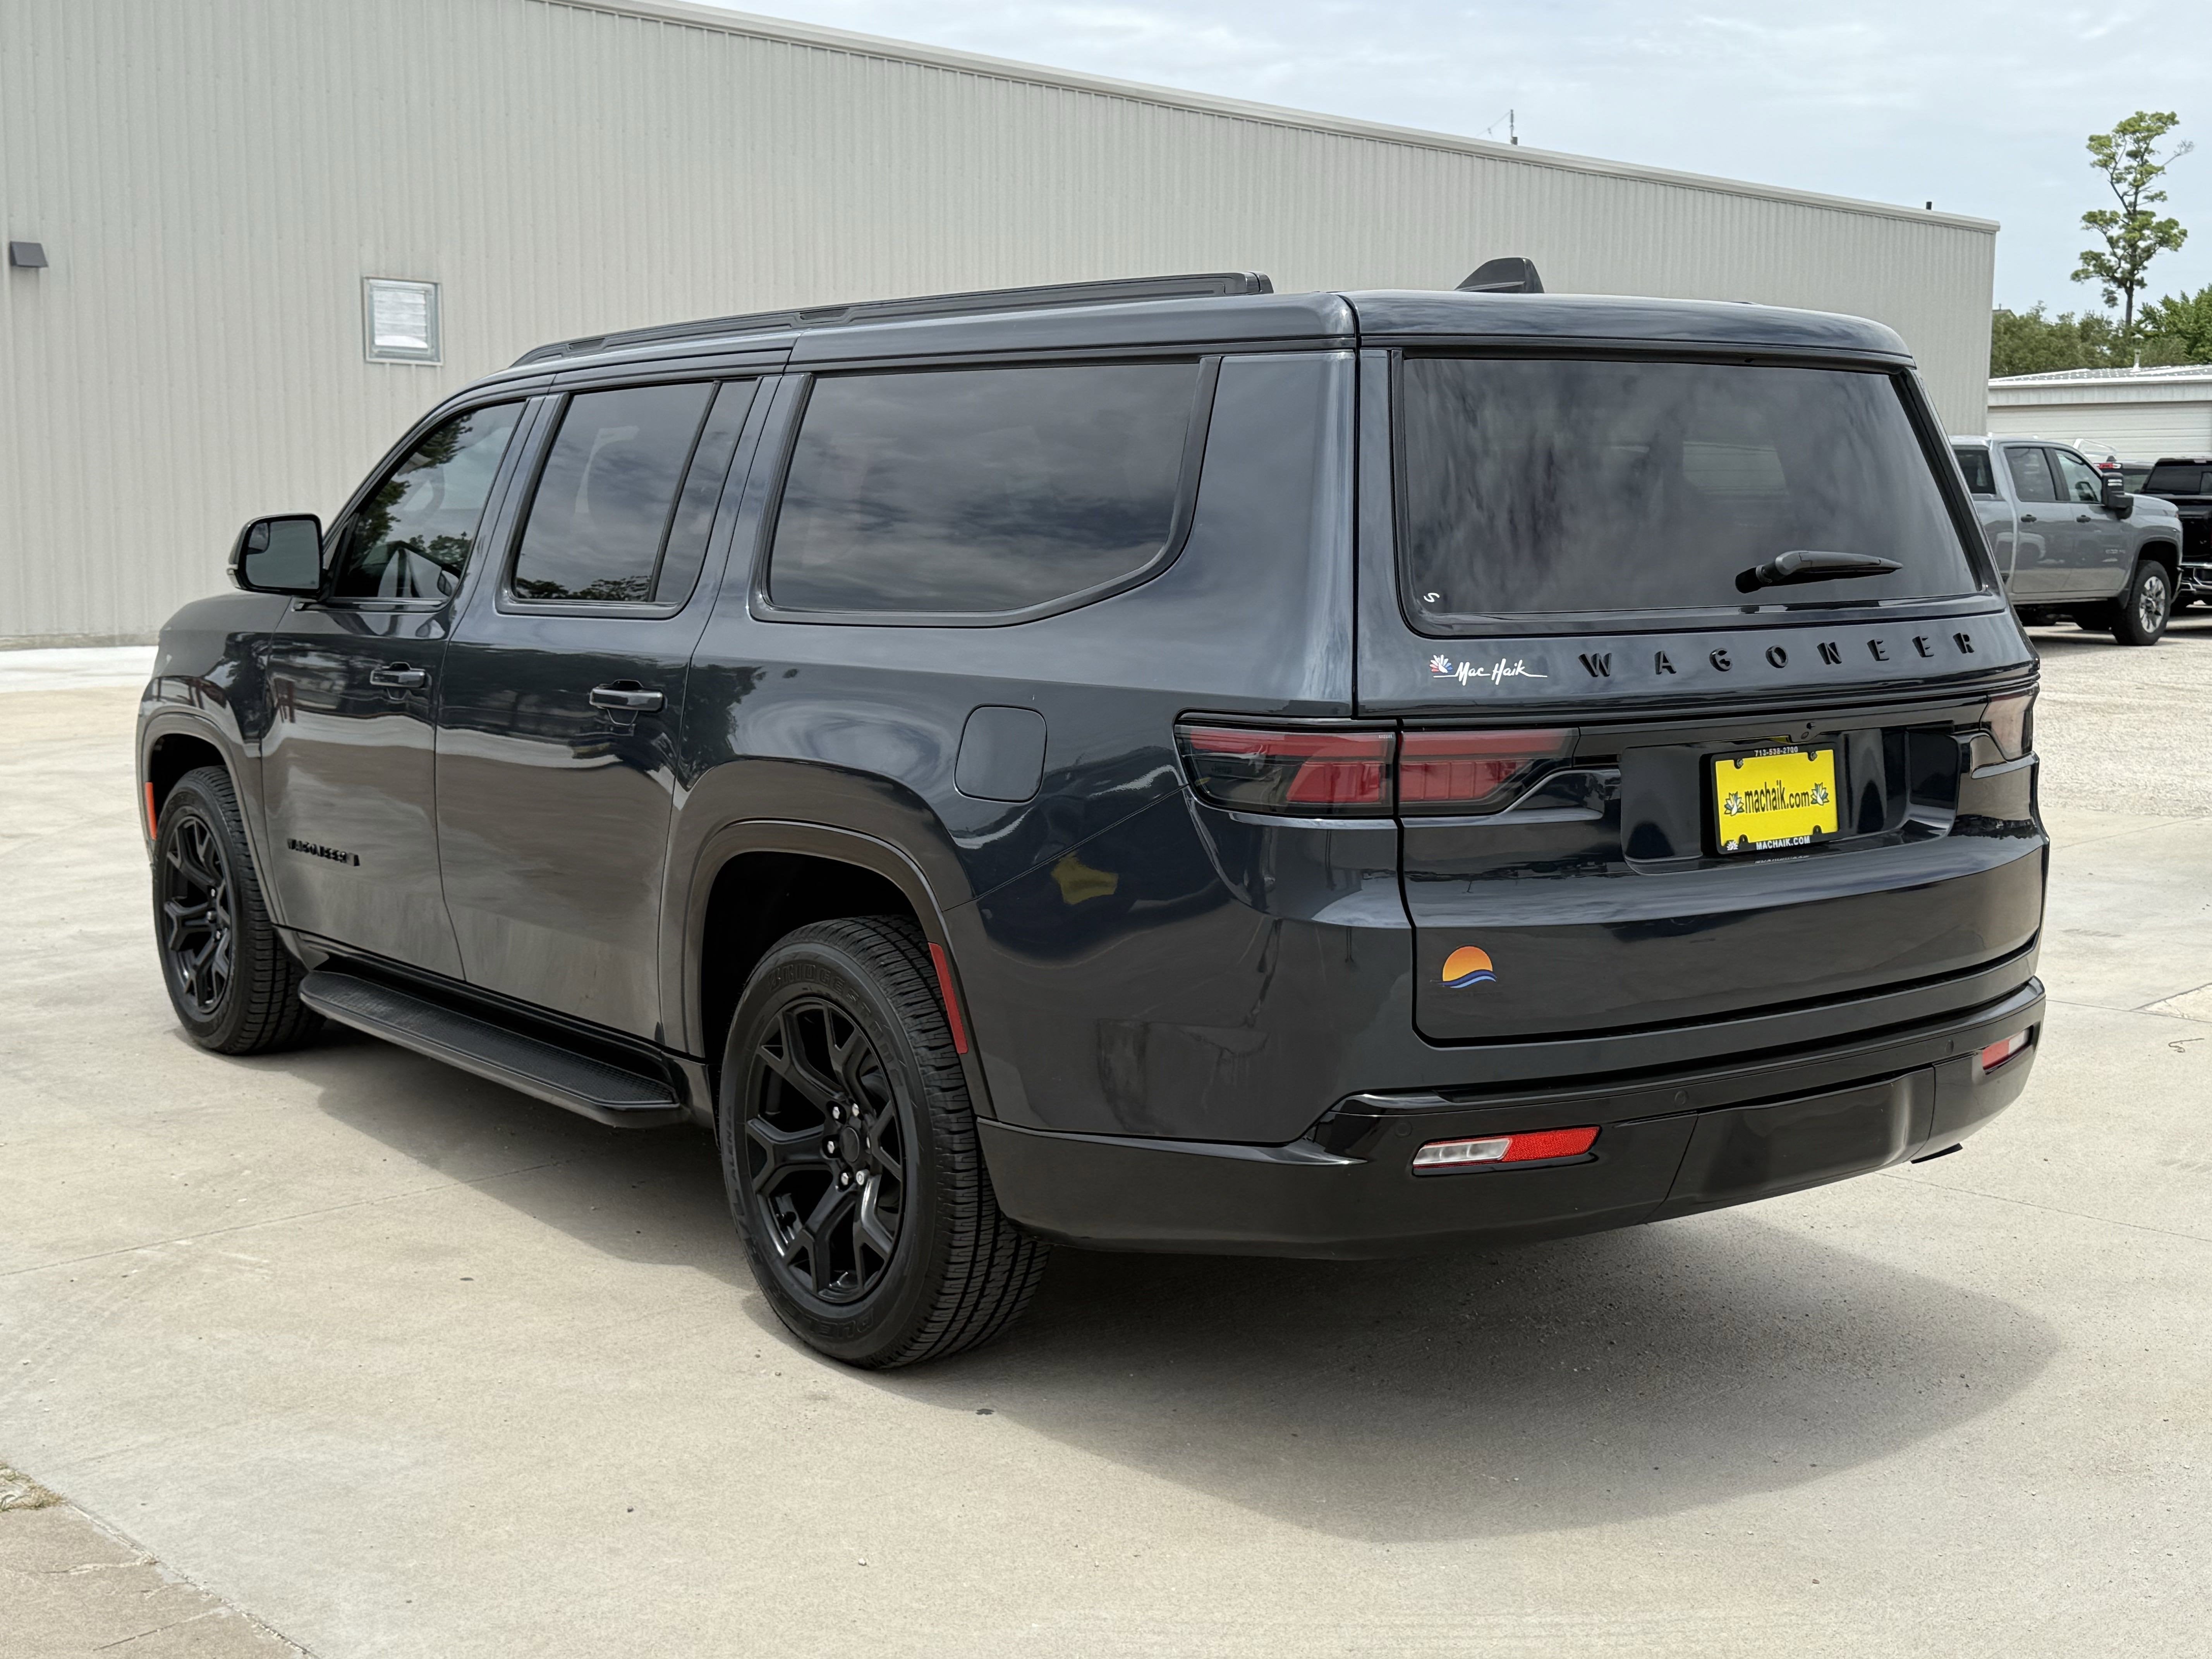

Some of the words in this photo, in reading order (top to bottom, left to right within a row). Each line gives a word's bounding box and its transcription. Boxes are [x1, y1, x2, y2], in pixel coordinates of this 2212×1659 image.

[1578, 632, 1975, 678] WAGONEER
[1434, 661, 1491, 686] Mac
[1491, 658, 1548, 685] Haik
[1754, 746, 1798, 757] 713-538-2700
[1744, 779, 1810, 814] machaik.com
[1756, 836, 1810, 850] MACHAIK.COM
